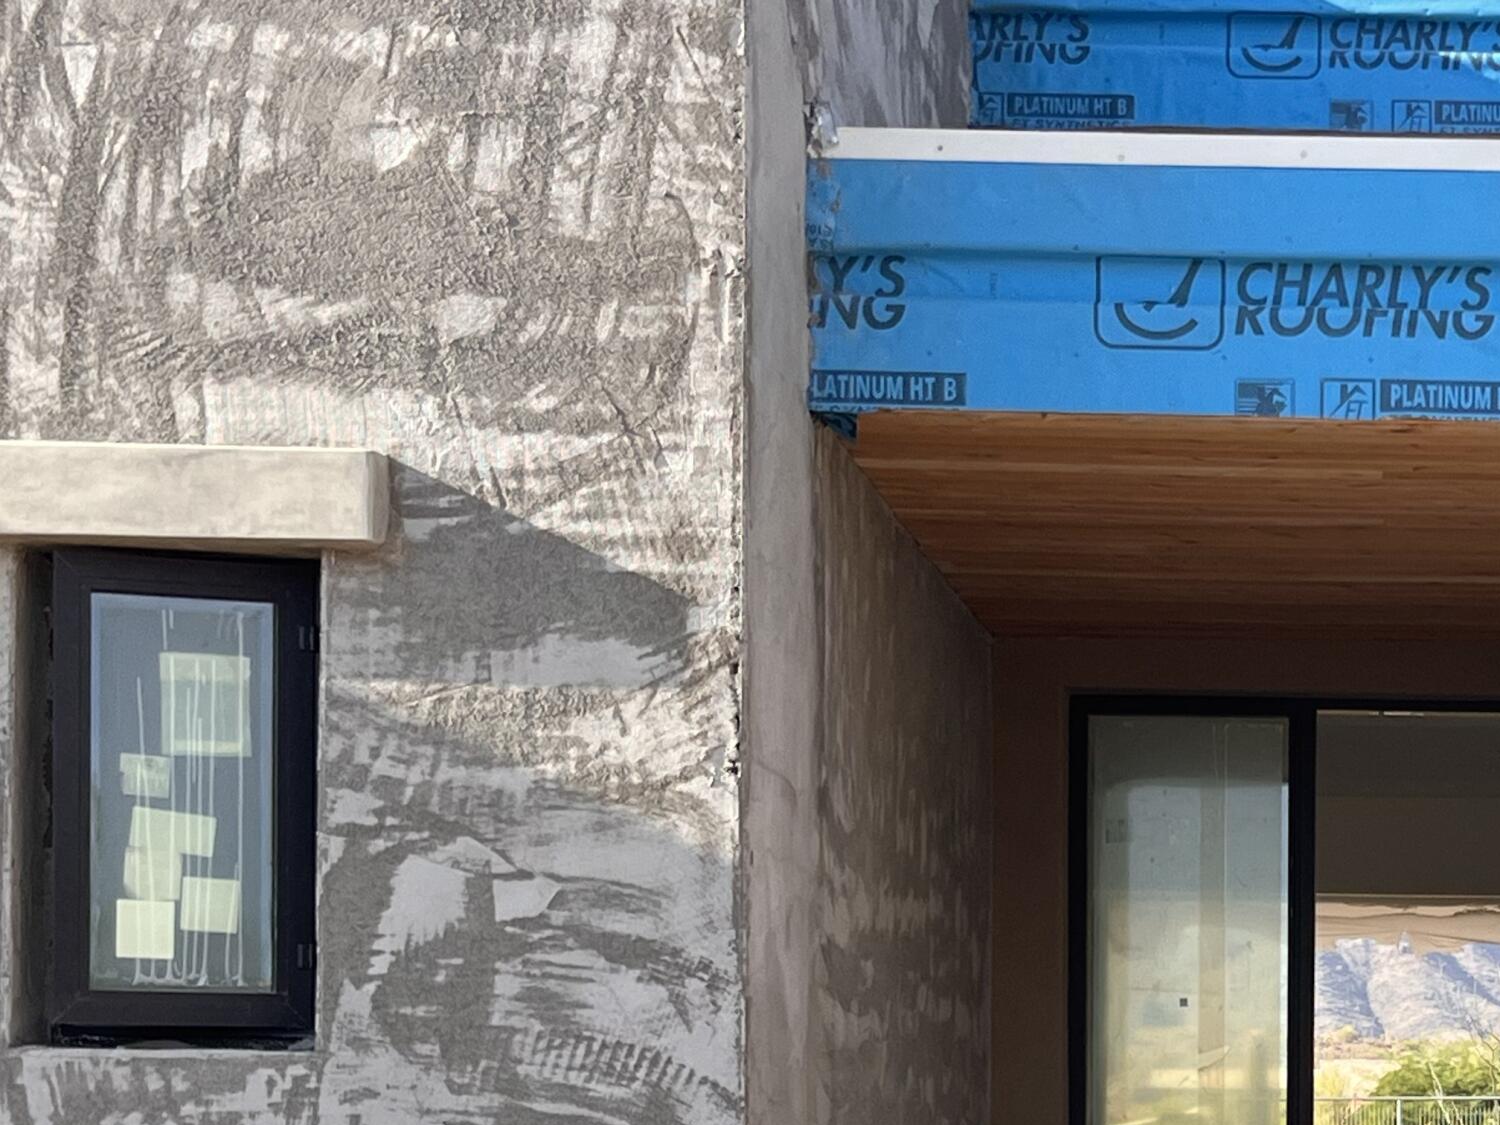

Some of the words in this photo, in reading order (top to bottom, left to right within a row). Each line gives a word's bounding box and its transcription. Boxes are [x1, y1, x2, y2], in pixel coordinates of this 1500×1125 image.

[1014, 96, 1089, 115] PLATINUM
[1094, 98, 1112, 115] HT
[1117, 98, 1127, 116] B
[1236, 262, 1493, 311] CHARLY'S
[910, 376, 935, 400] HT
[944, 377, 957, 401] B
[1391, 384, 1490, 410] PLATINUM
